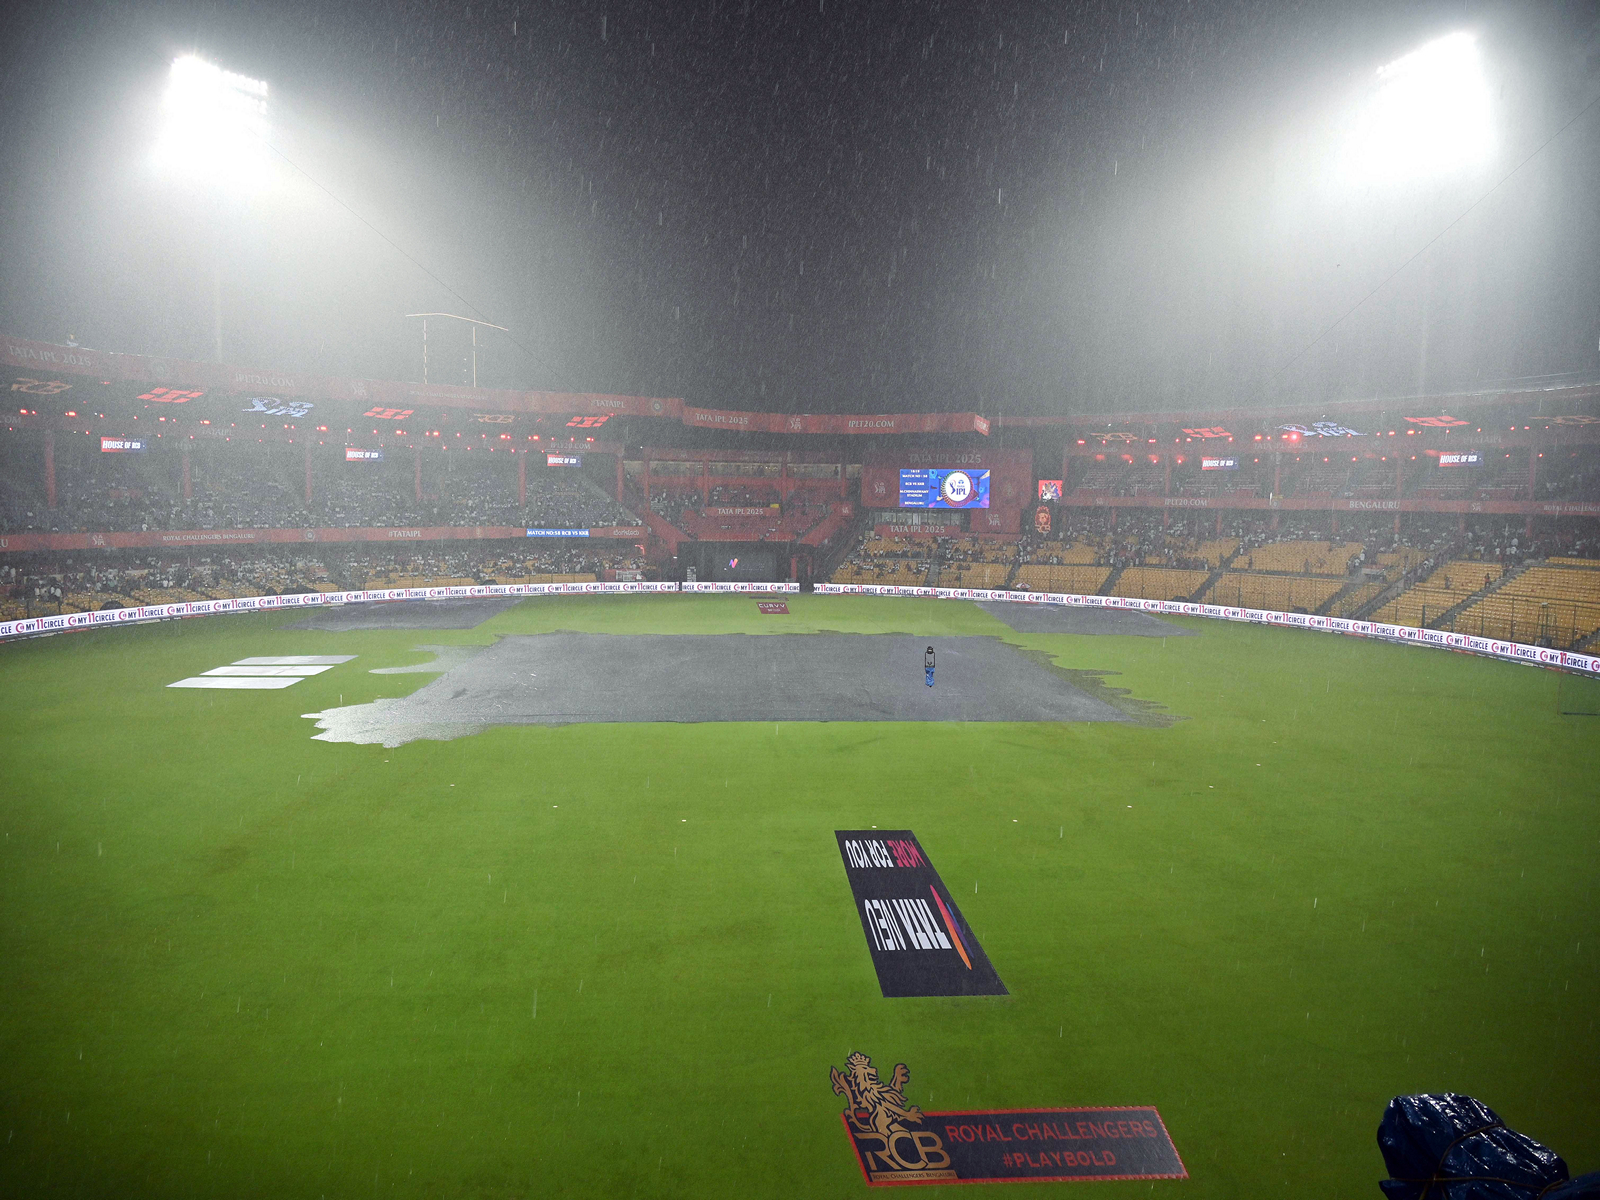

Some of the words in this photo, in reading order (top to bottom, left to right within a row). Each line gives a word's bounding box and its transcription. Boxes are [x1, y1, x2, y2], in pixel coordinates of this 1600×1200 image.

[7, 346, 37, 360] TATA
[40, 351, 56, 362] IPL
[695, 413, 713, 422] TATA
[715, 415, 727, 423] IPL
[728, 415, 749, 424] 2025
[848, 420, 895, 429] IPLT20.COM
[102, 440, 123, 449] HOUSE
[124, 441, 132, 449] OF
[346, 450, 364, 459] HOUSE
[364, 451, 371, 459] OF
[908, 454, 933, 464] TATA
[955, 454, 982, 464] 2025
[1440, 455, 1460, 464] HOUSE
[1164, 498, 1208, 506] IPLT20.COM
[1350, 500, 1400, 510] BENGALURU
[388, 530, 421, 538] #TATAIPL
[890, 525, 908, 533] TATA
[911, 525, 922, 533] IPL
[924, 525, 945, 533] 2025
[845, 840, 873, 868] YOU
[865, 840, 894, 868] FOR
[887, 840, 926, 868] MORE
[864, 899, 906, 951] NEU
[892, 899, 952, 949] TATA
[945, 1124, 1012, 1142] ROYAL
[1012, 1120, 1158, 1141] CHALLENGERS
[854, 1131, 950, 1170] RCB
[1002, 1150, 1116, 1168] #PLAYBOLD
